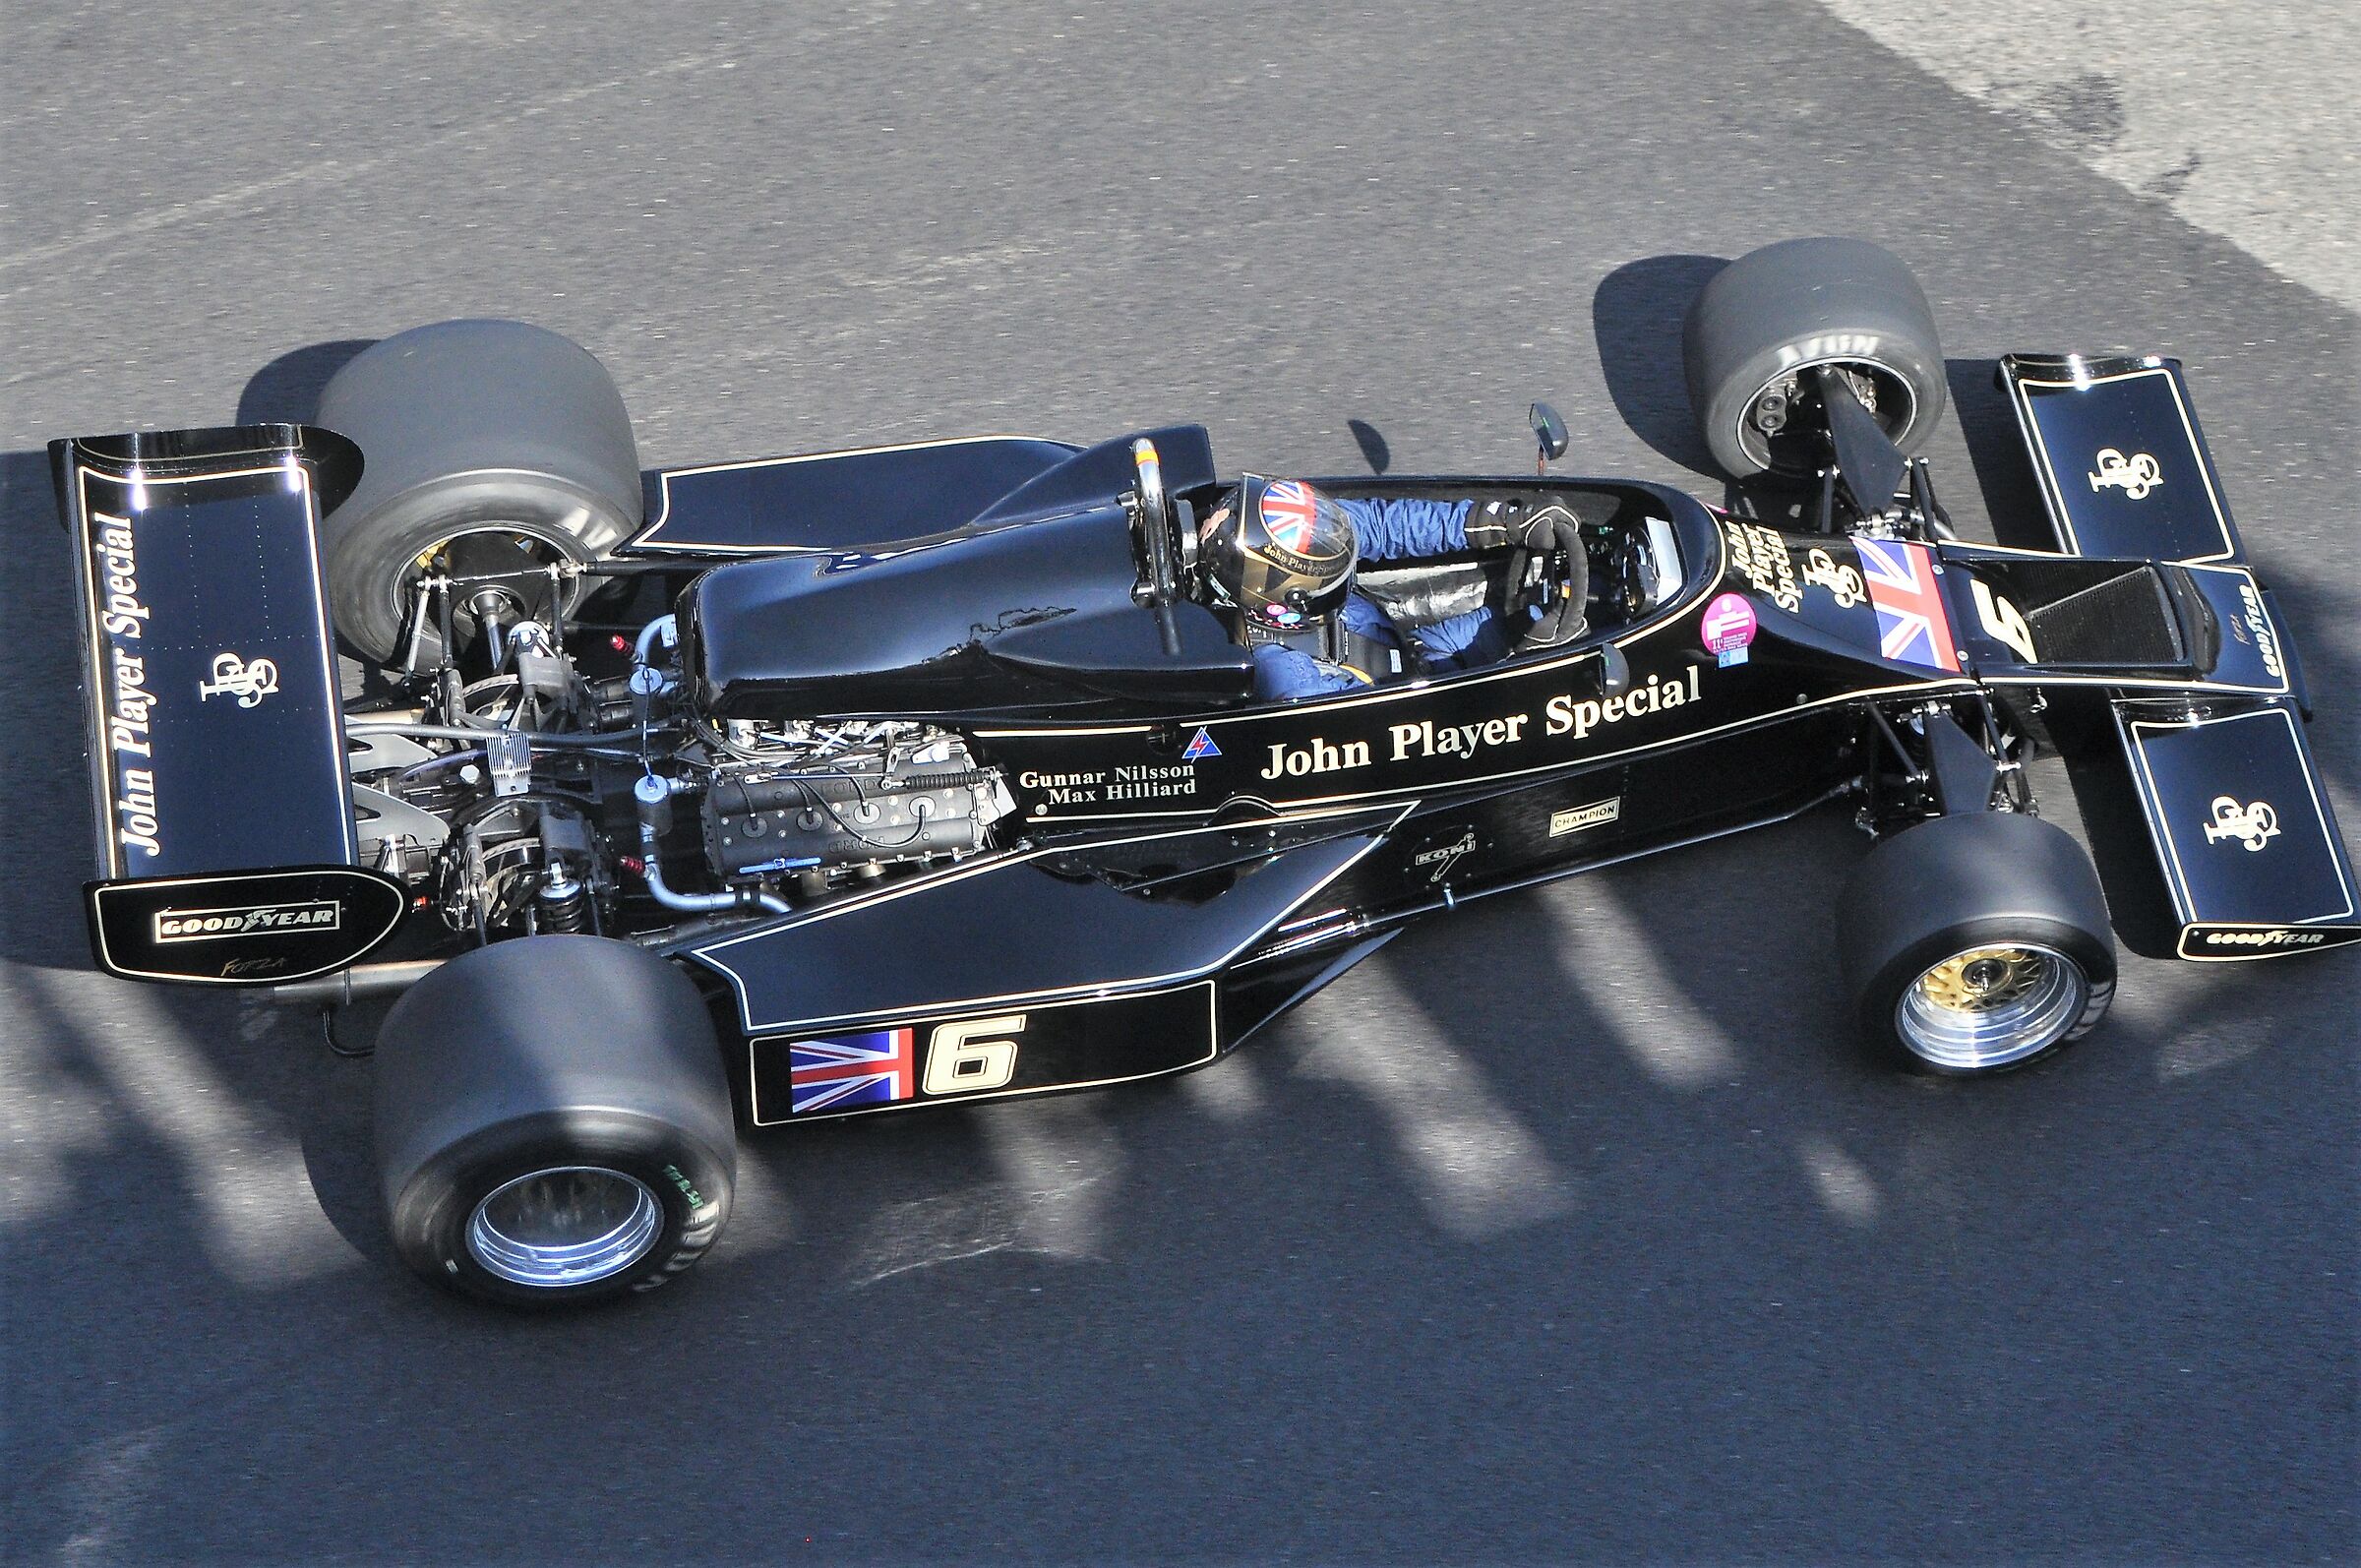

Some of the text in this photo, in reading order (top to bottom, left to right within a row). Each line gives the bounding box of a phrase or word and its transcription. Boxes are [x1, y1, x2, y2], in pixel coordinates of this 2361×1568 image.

[1264, 542, 1287, 564] John
[1725, 520, 1753, 579] John
[1741, 522, 1776, 598] Player
[1756, 525, 1803, 614] Special
[2239, 584, 2281, 678] GOODYEAR
[94, 512, 160, 857] John Player Special
[1260, 665, 1702, 780] John Player Special
[1019, 764, 1195, 789] Gunnar Nilsson
[1048, 779, 1196, 805] Max Hilliard
[1554, 805, 1615, 829] CHAMPION
[1418, 841, 1475, 864] KONI
[161, 909, 334, 935] GOODYEAR
[2207, 930, 2325, 947] GOODYEAR
[922, 1014, 1027, 1096] 6
